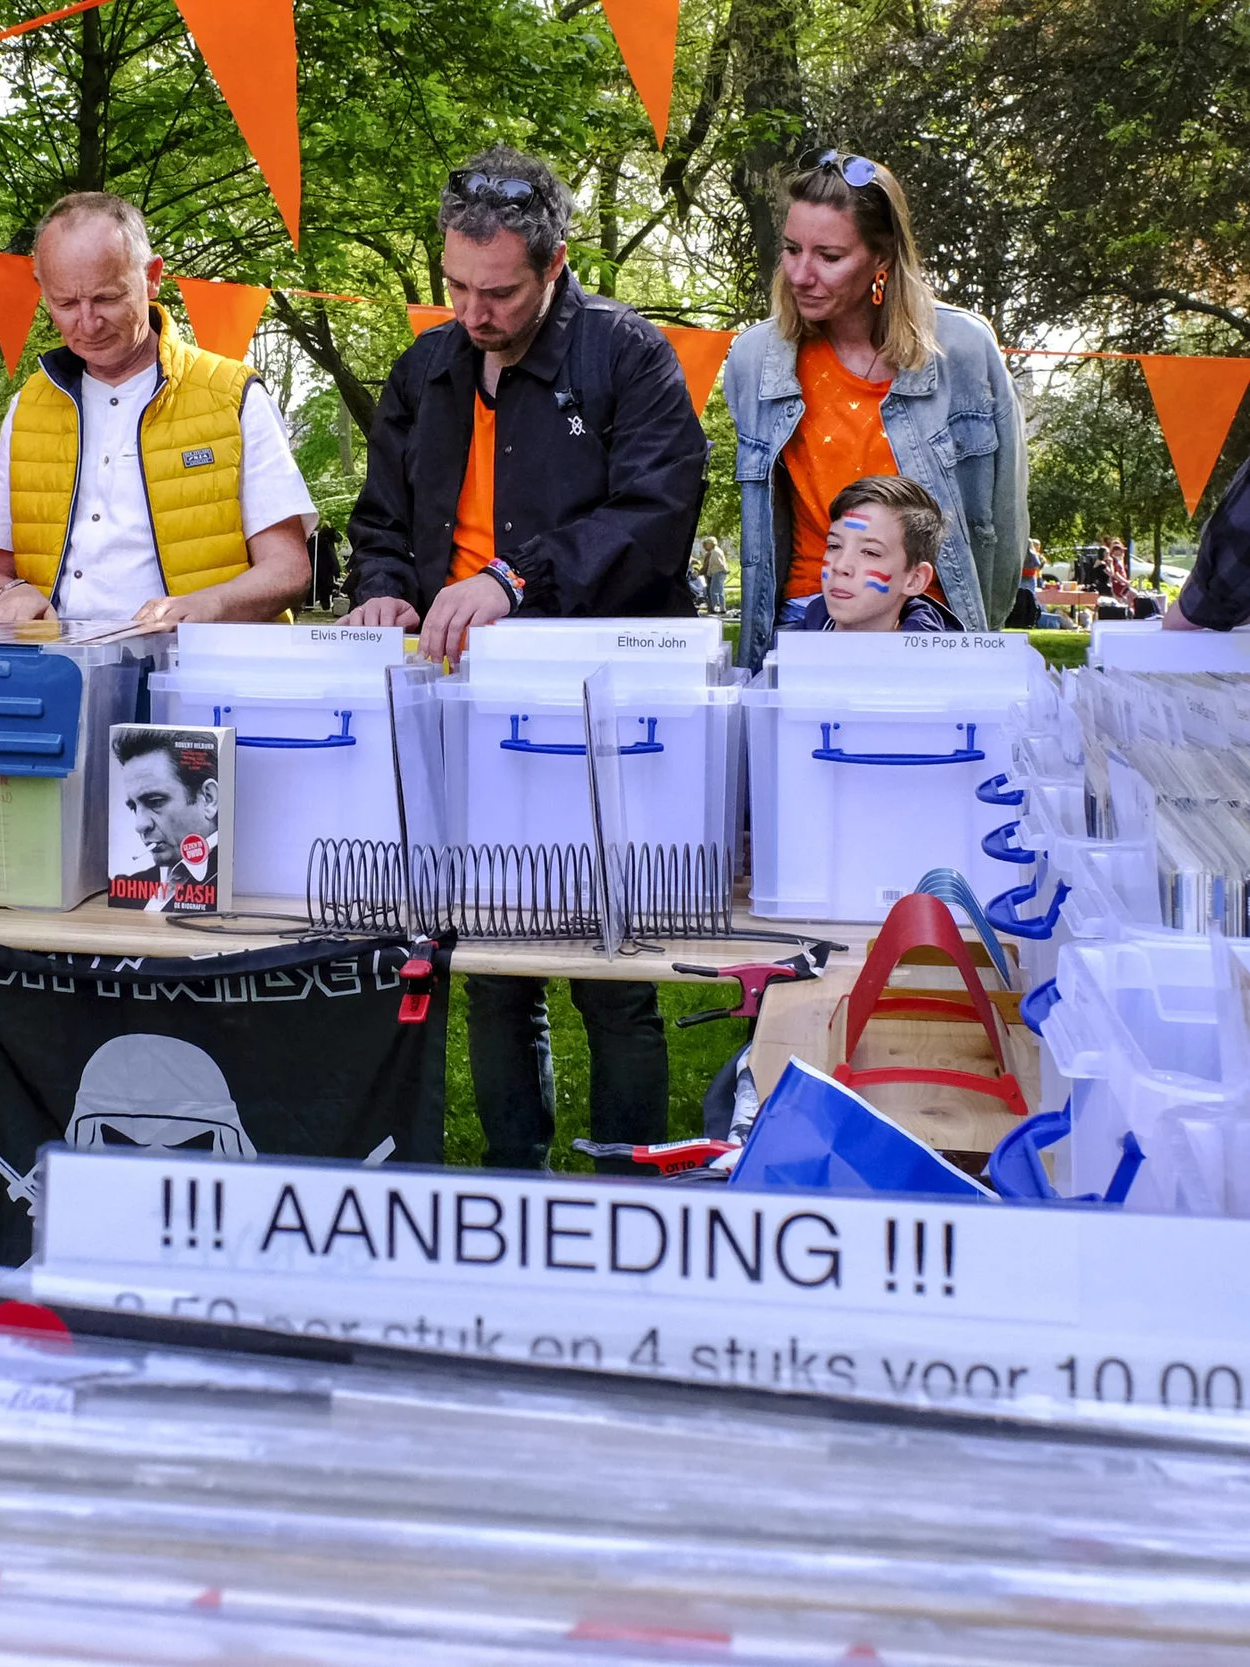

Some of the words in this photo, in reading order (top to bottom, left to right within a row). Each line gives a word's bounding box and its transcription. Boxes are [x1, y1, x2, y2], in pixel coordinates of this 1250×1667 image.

[310, 629, 338, 641] Elvis
[340, 630, 383, 643] Presley
[617, 636, 655, 648] Elthon
[657, 636, 687, 649] John
[902, 635, 929, 648] 70's
[932, 636, 957, 649] Pop
[960, 636, 970, 649] &
[974, 636, 1006, 649] Rock
[110, 879, 170, 899] JOHNNY
[174, 883, 216, 905] CASH
[259, 1182, 843, 1289] AANBIEDING
[626, 1326, 665, 1374] 4
[691, 1334, 858, 1393] stuks
[880, 1356, 1030, 1401] voor
